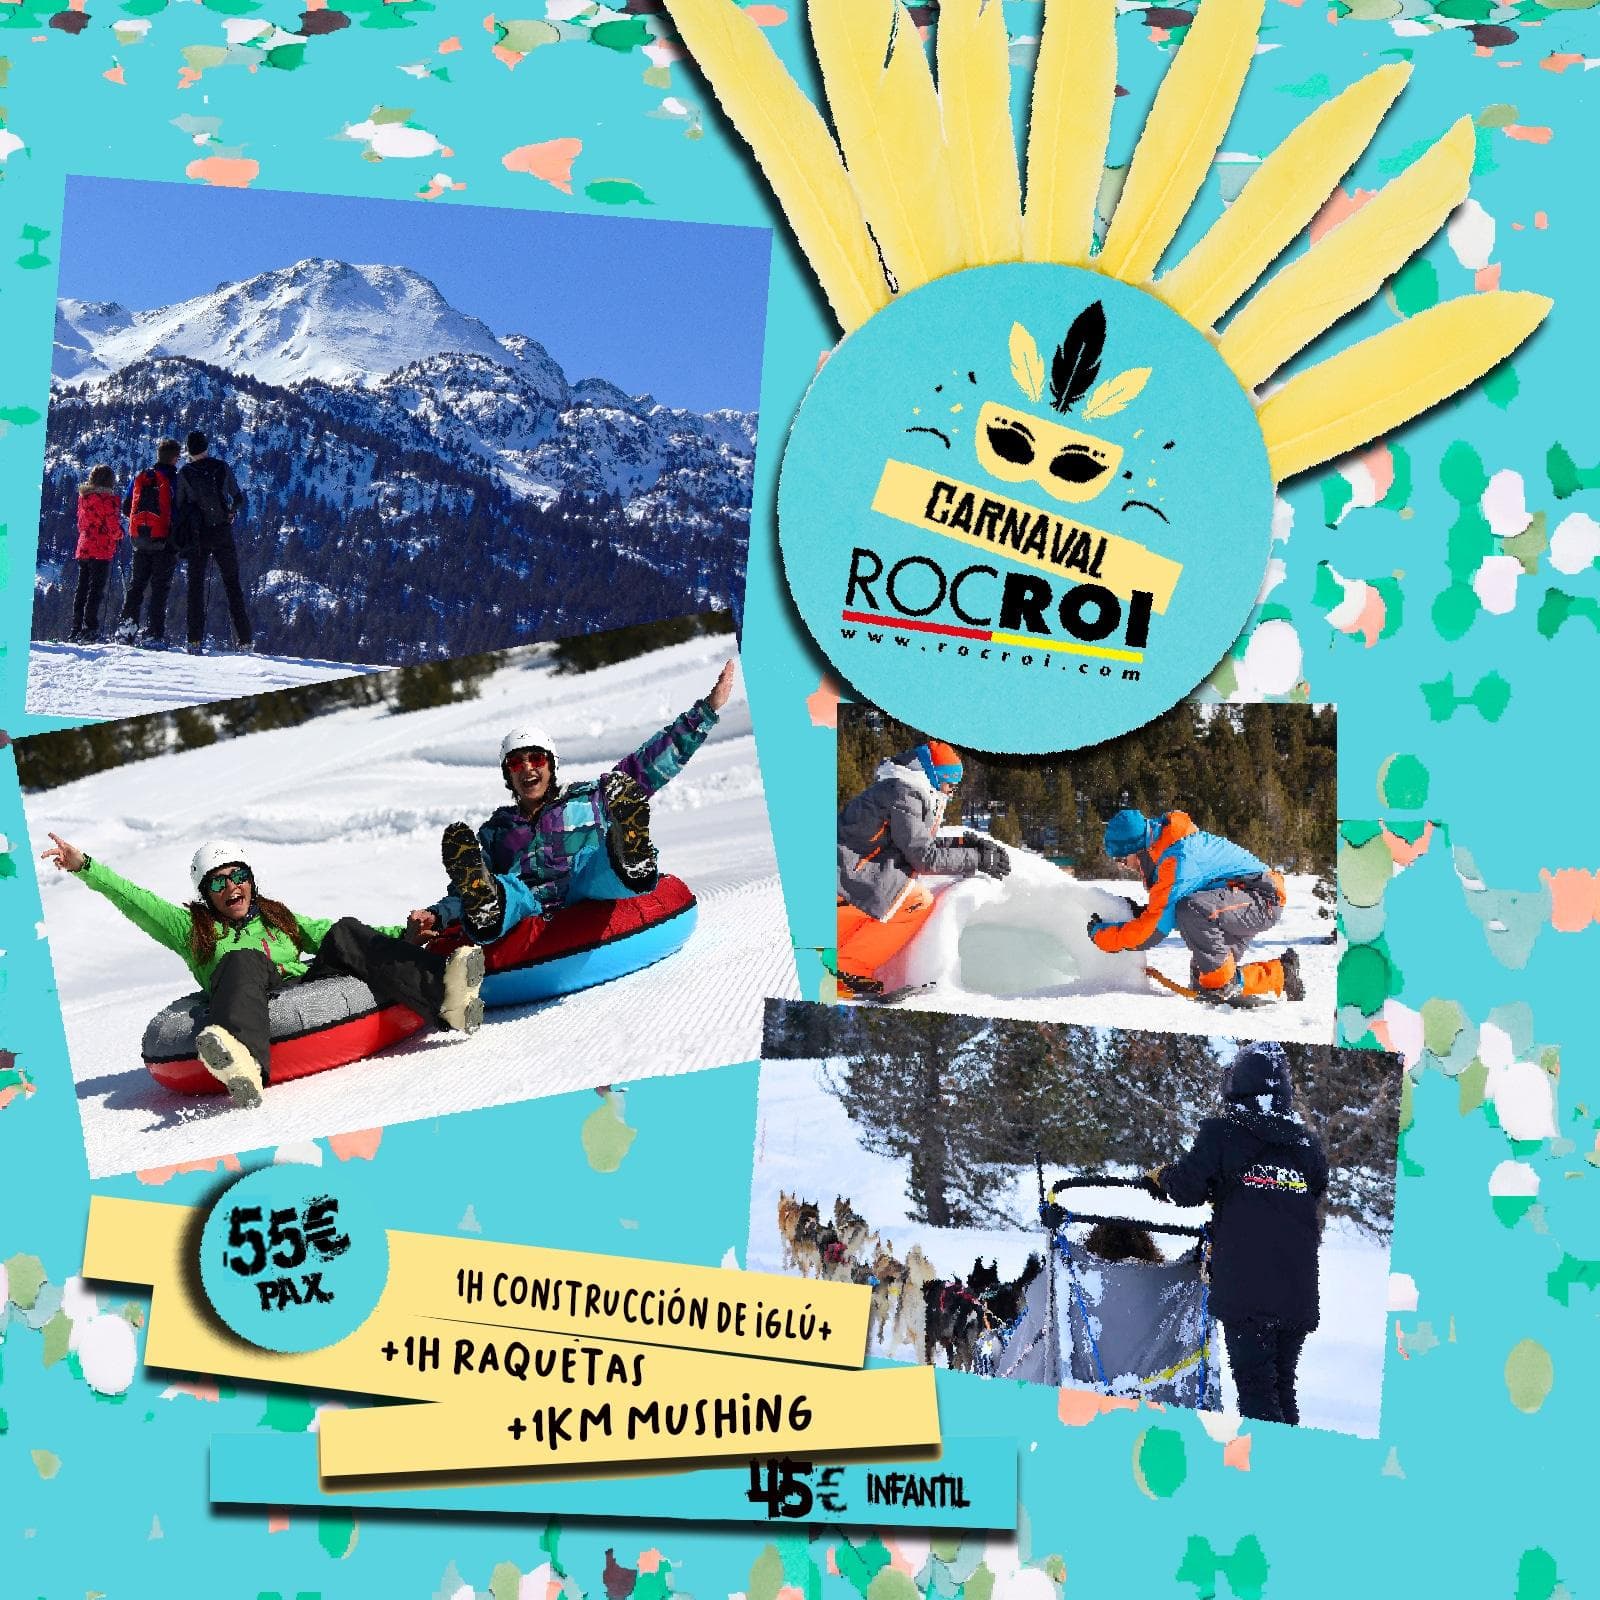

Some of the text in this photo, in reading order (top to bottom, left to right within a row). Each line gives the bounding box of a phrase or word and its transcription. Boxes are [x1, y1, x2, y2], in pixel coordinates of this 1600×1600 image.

[924, 480, 1108, 579] CARNAVAL
[845, 547, 1154, 649] ROCROI
[840, 626, 1142, 682] www.rocroi.com
[222, 1194, 351, 1277] 55€
[457, 1268, 483, 1304] 1H
[717, 1301, 747, 1337] DE
[453, 1339, 645, 1387] RAQUETAS
[507, 1403, 612, 1450] +1KM
[867, 1472, 971, 1508] INFANTIL
